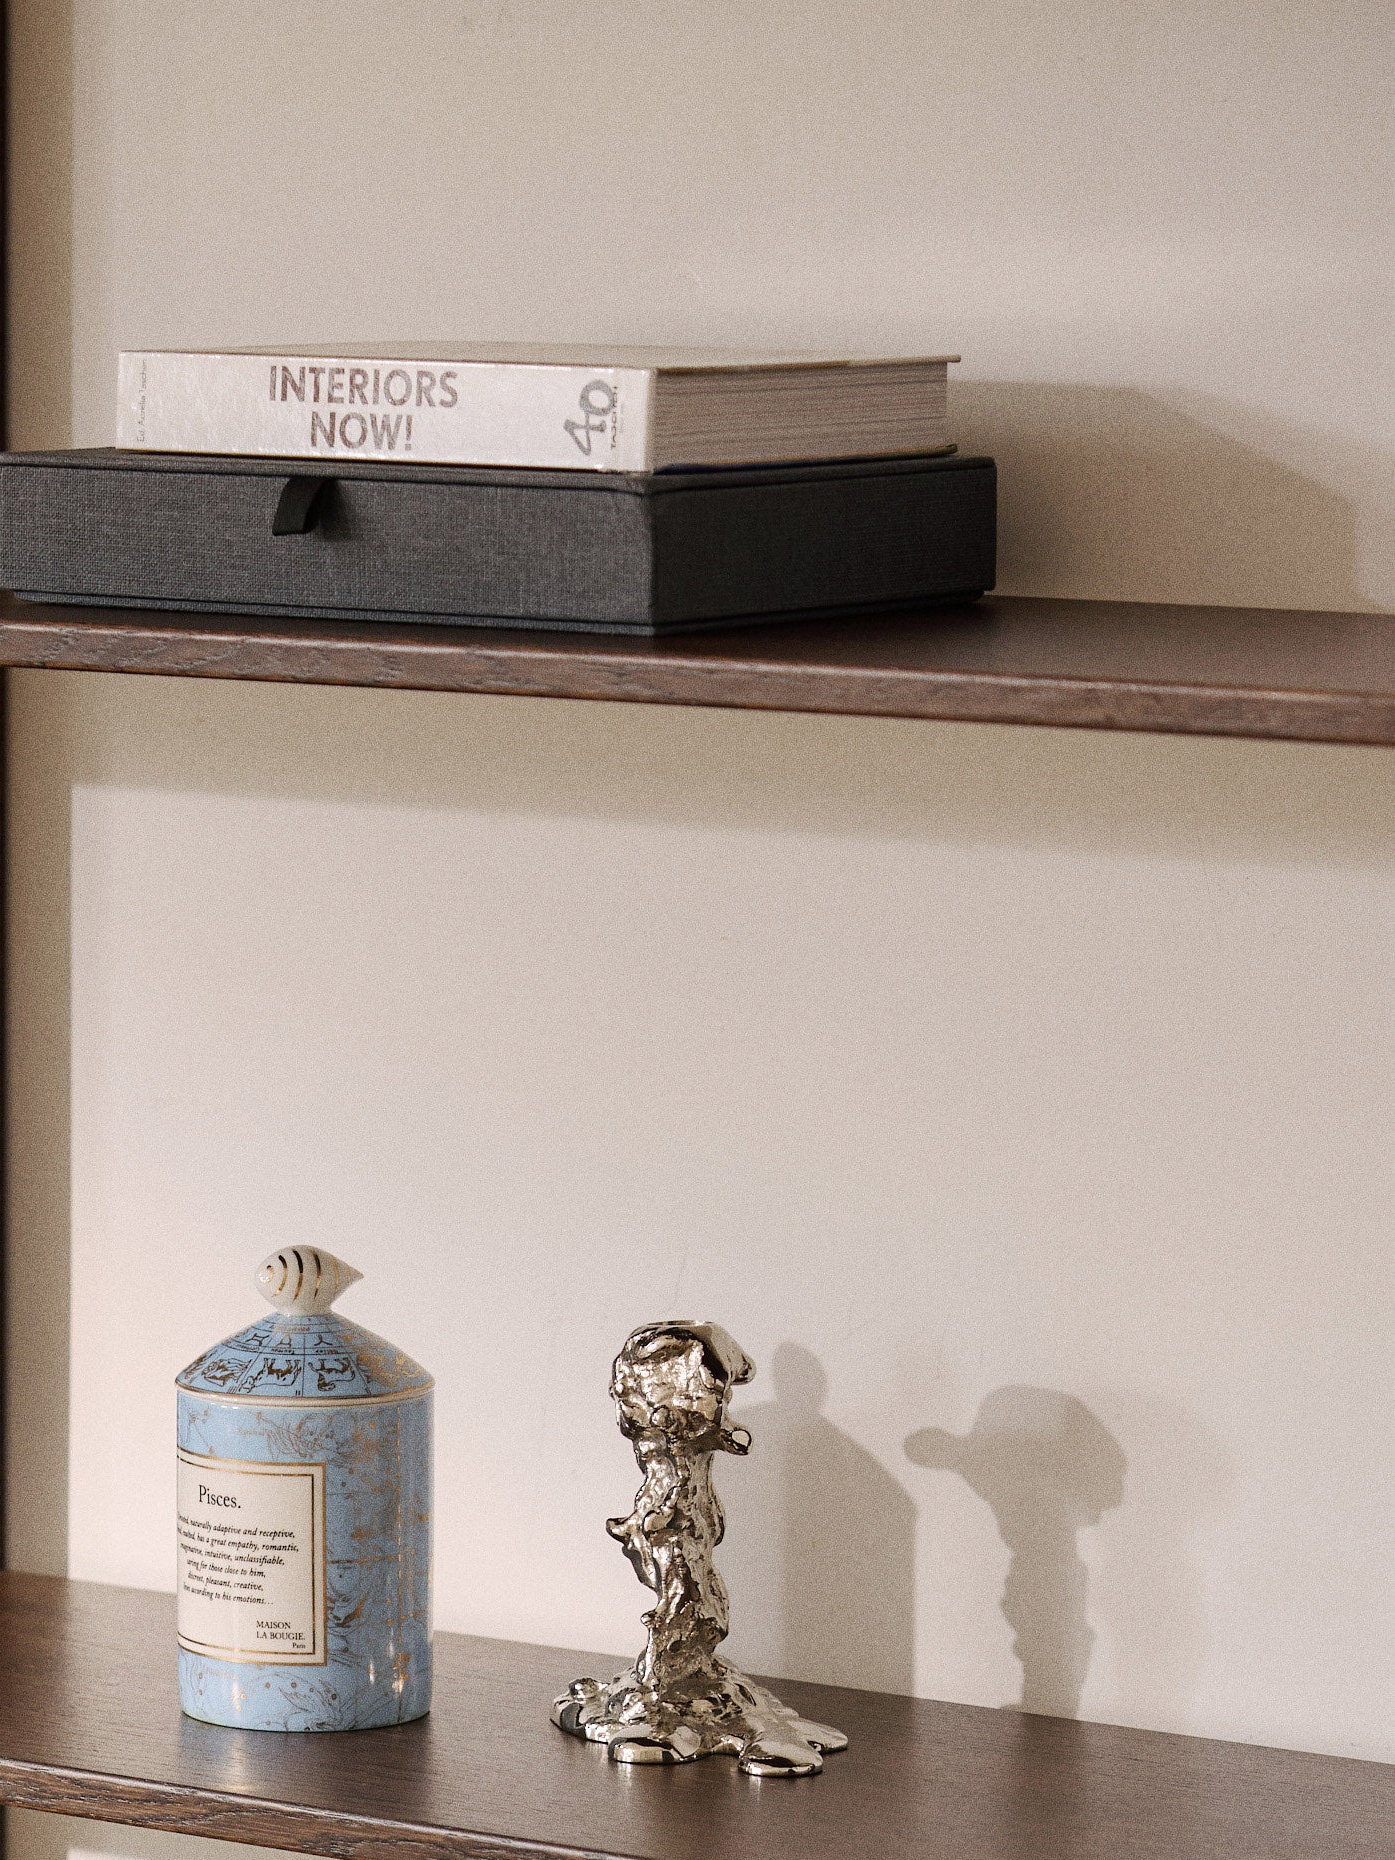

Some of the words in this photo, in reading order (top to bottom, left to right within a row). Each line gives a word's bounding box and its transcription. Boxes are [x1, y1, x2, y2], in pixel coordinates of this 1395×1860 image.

[269, 365, 458, 408] INTERIORS
[310, 411, 413, 451] NOW!
[198, 1484, 241, 1509] Pisces.
[212, 1522, 241, 1536] adaptive
[243, 1527, 258, 1537] and
[259, 1529, 295, 1541] receptive,
[210, 1537, 226, 1547] great
[227, 1540, 259, 1551] empathy,
[262, 1543, 299, 1552] romantic,
[204, 1550, 233, 1561] intuitive,
[234, 1553, 285, 1566] unclassifiable,
[209, 1563, 223, 1573] those
[224, 1566, 239, 1575] close
[249, 1568, 266, 1578] him,
[205, 1576, 231, 1588] pleasant,
[233, 1581, 264, 1591] creative,
[222, 1592, 231, 1601] his
[256, 1620, 291, 1629] MAISON
[256, 1631, 267, 1639] LA
[270, 1632, 306, 1640] BOUGIE.
